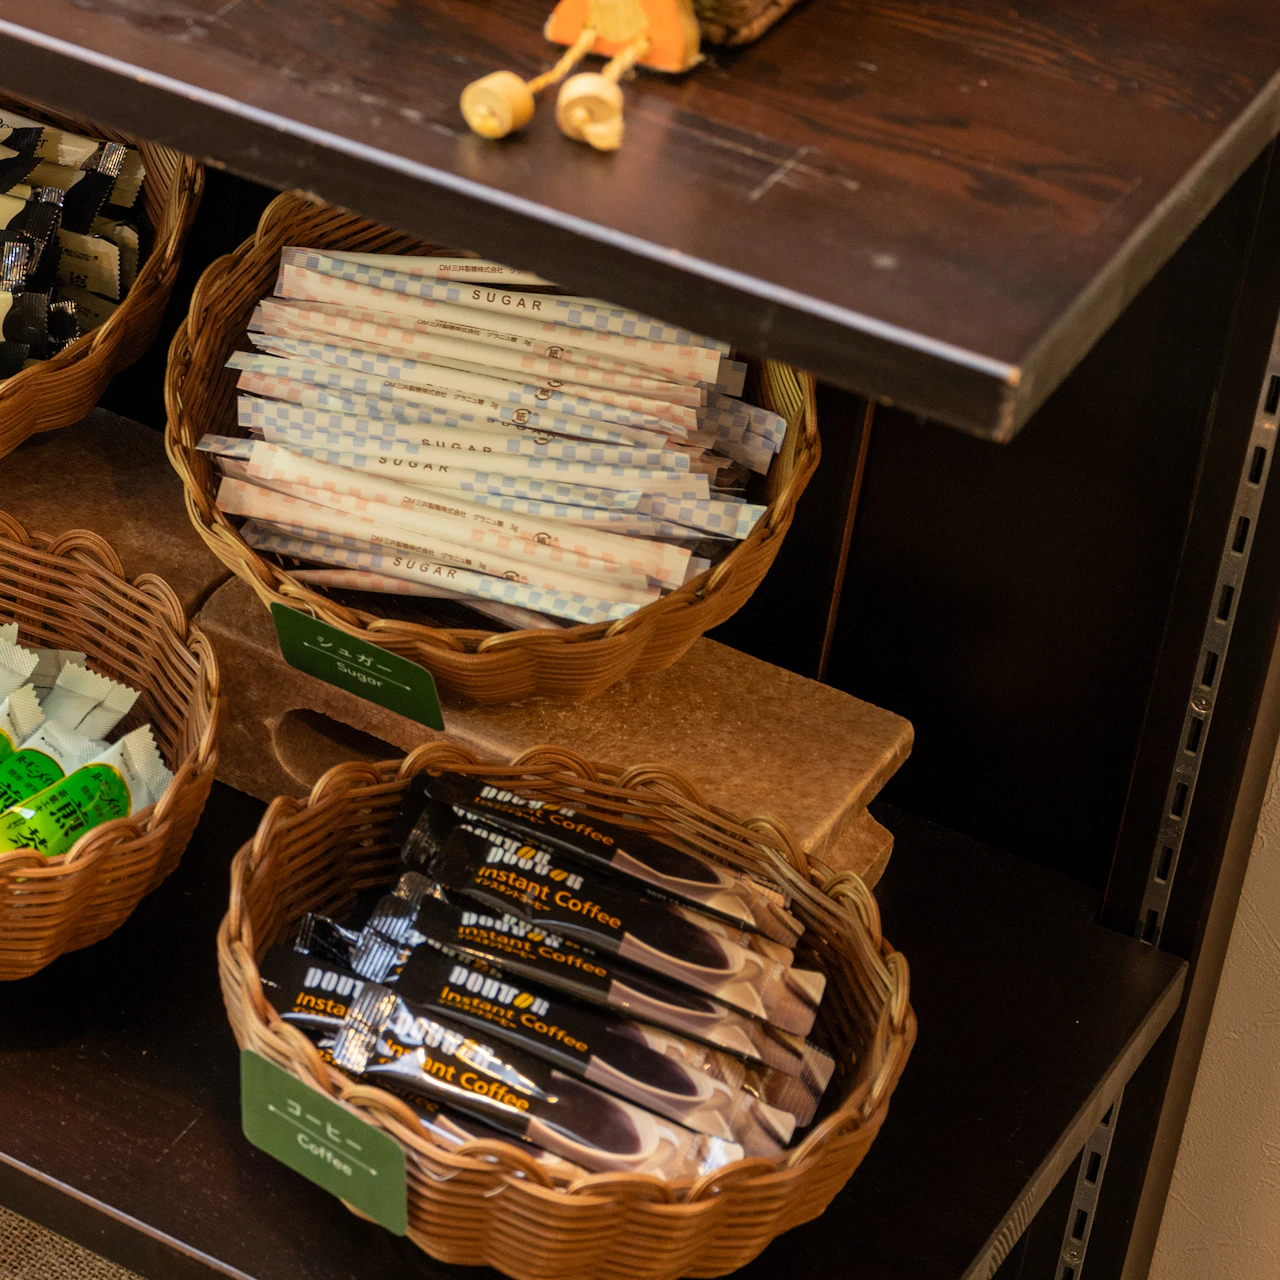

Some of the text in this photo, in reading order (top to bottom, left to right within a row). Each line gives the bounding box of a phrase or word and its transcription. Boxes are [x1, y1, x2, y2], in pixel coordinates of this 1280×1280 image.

[472, 289, 542, 311] SUGAR
[487, 332, 517, 343] グラニュ糖
[453, 393, 484, 405] グラニュ糖
[421, 439, 492, 453] SUGAR
[378, 456, 449, 472] SUGAR
[473, 514, 504, 528] グラニュ糖
[393, 556, 457, 579] SUGAR
[441, 553, 472, 566] グラニュ糖
[315, 634, 395, 674] シュガー
[336, 659, 384, 690] Sugar
[549, 813, 615, 846] Coffee
[486, 846, 585, 891] DOUTOR
[478, 866, 622, 930] Instant Coffee
[457, 926, 533, 951] Instant
[537, 946, 607, 977] Coffee
[448, 965, 550, 1017] DOUTOR
[440, 986, 589, 1053] Instant Coffee
[459, 1071, 530, 1113] Coffee
[284, 1097, 363, 1153] コーヒー
[296, 1131, 354, 1178] Coffee
